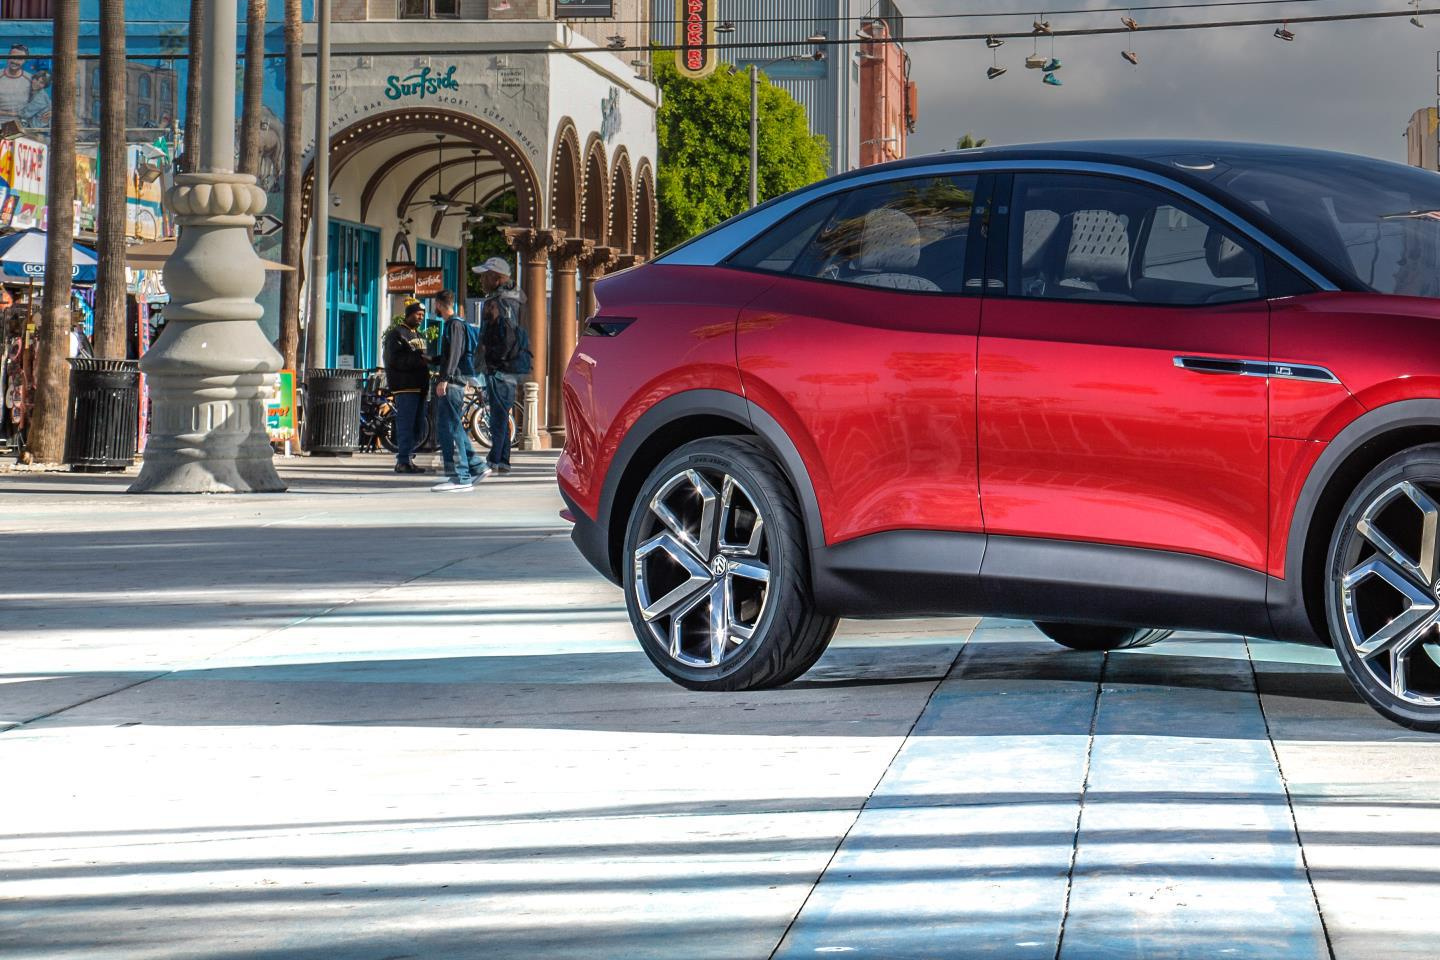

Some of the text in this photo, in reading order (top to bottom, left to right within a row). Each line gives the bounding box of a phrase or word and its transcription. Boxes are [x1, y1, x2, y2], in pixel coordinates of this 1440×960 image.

[384, 65, 459, 101] Surfside
[363, 100, 382, 112] BAR
[438, 95, 540, 156] SPORT SURF MUSIC
[16, 143, 46, 183] STORE
